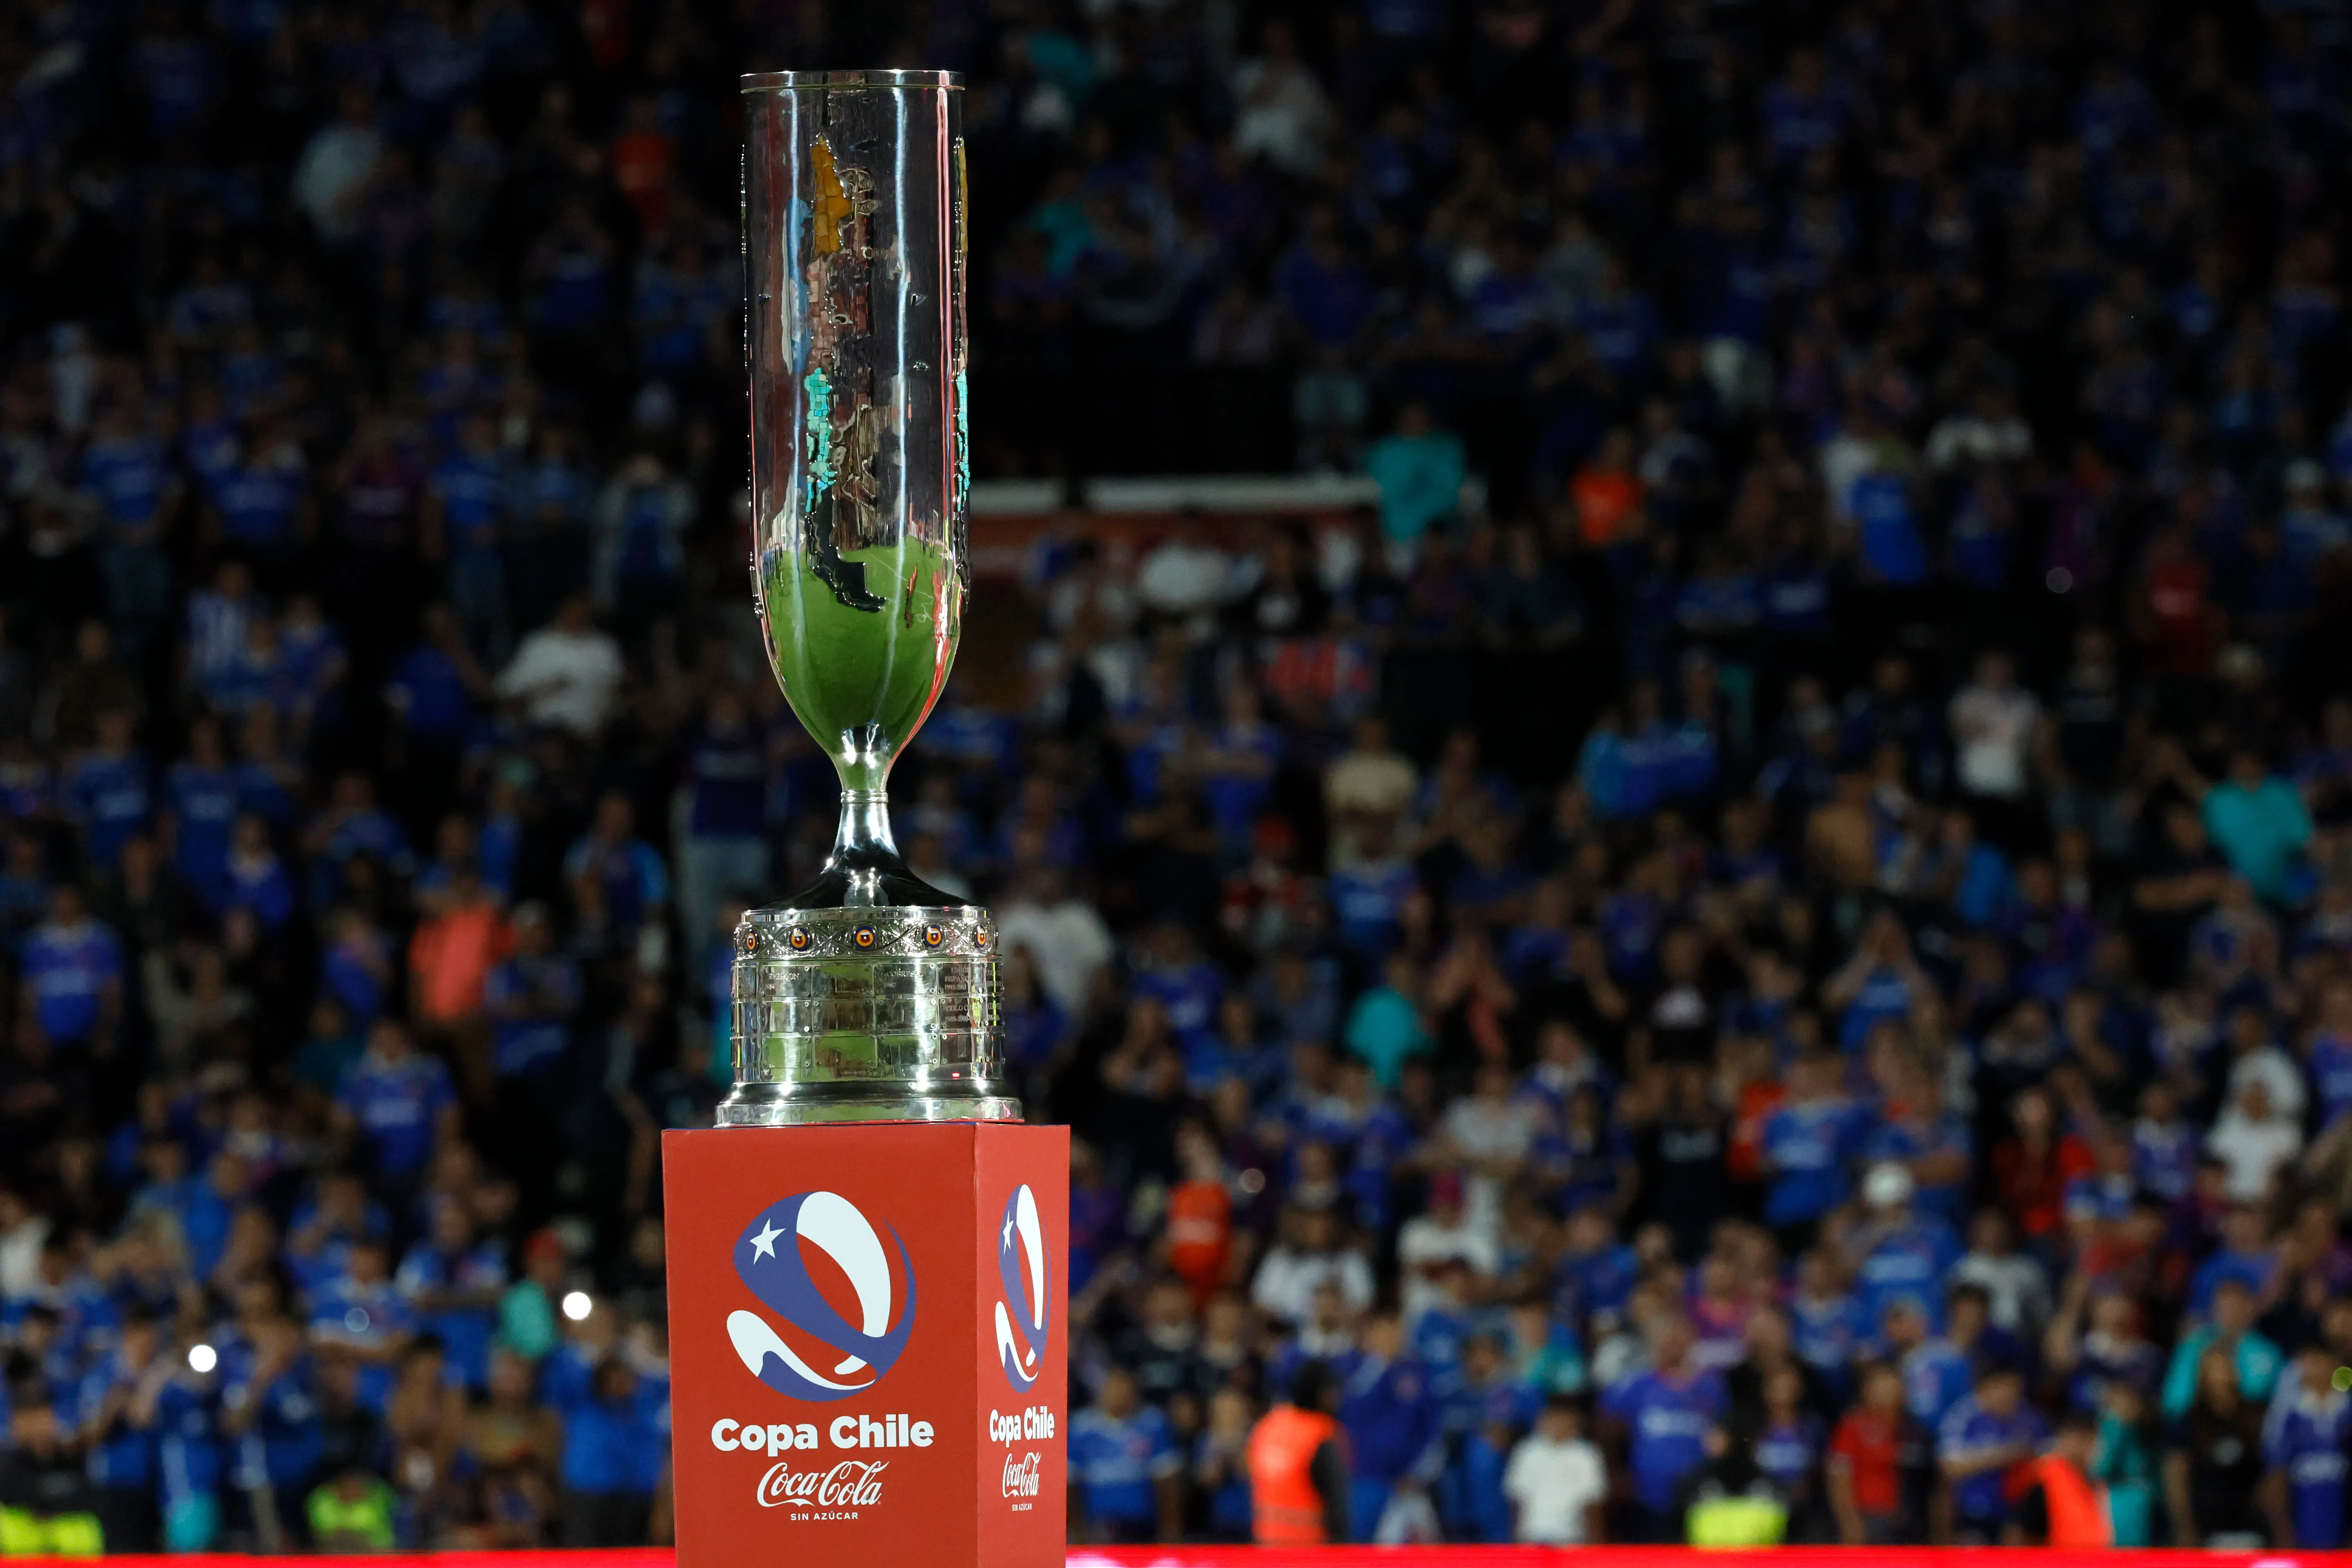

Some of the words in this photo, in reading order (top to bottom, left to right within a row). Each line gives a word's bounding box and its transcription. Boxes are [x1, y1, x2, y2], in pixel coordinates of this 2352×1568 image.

[711, 1418, 818, 1457] Copa
[830, 1414, 934, 1449] Chile
[989, 1409, 1022, 1448] Copa
[1023, 1406, 1055, 1440] Chile
[757, 1460, 890, 1507] Coca-Cola
[1002, 1452, 1041, 1498] Coca-Cola
[813, 1510, 858, 1520] AZÚCAR
[1019, 1502, 1033, 1511] AZÚCAR
